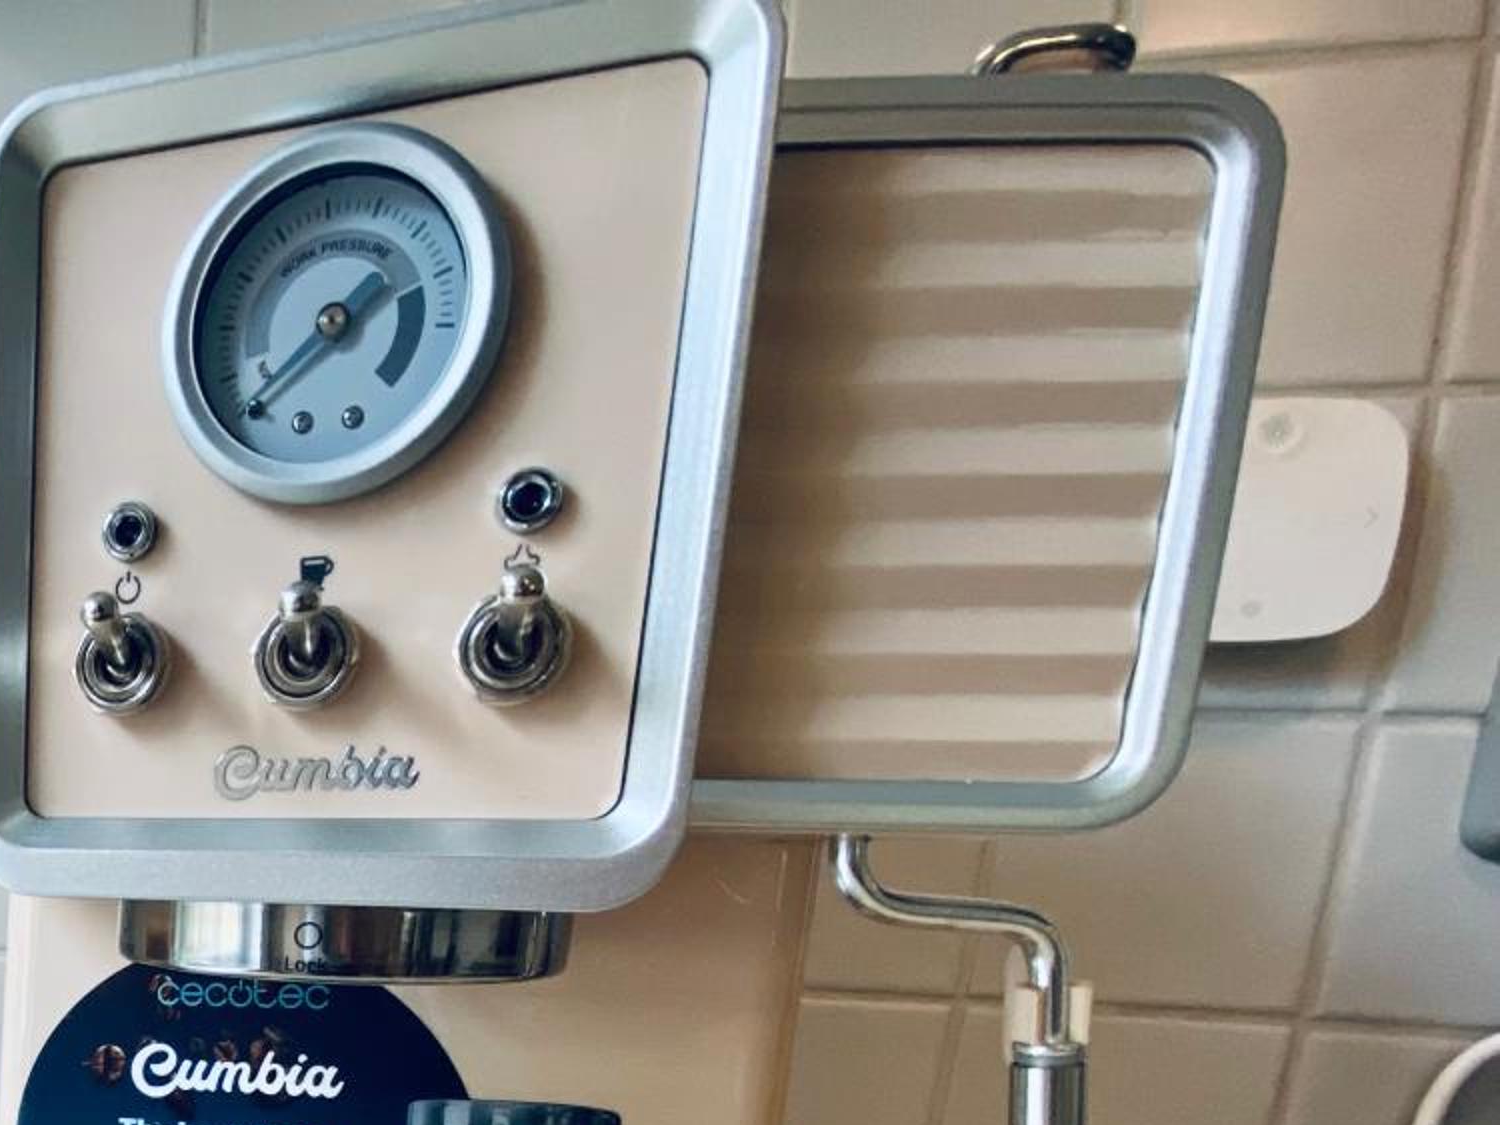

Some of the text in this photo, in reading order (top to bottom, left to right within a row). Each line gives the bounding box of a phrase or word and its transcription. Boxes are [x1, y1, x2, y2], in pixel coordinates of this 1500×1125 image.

[213, 744, 419, 800] Cumbia
[157, 977, 331, 1010] cecotec
[131, 1043, 345, 1099] Cumbia
